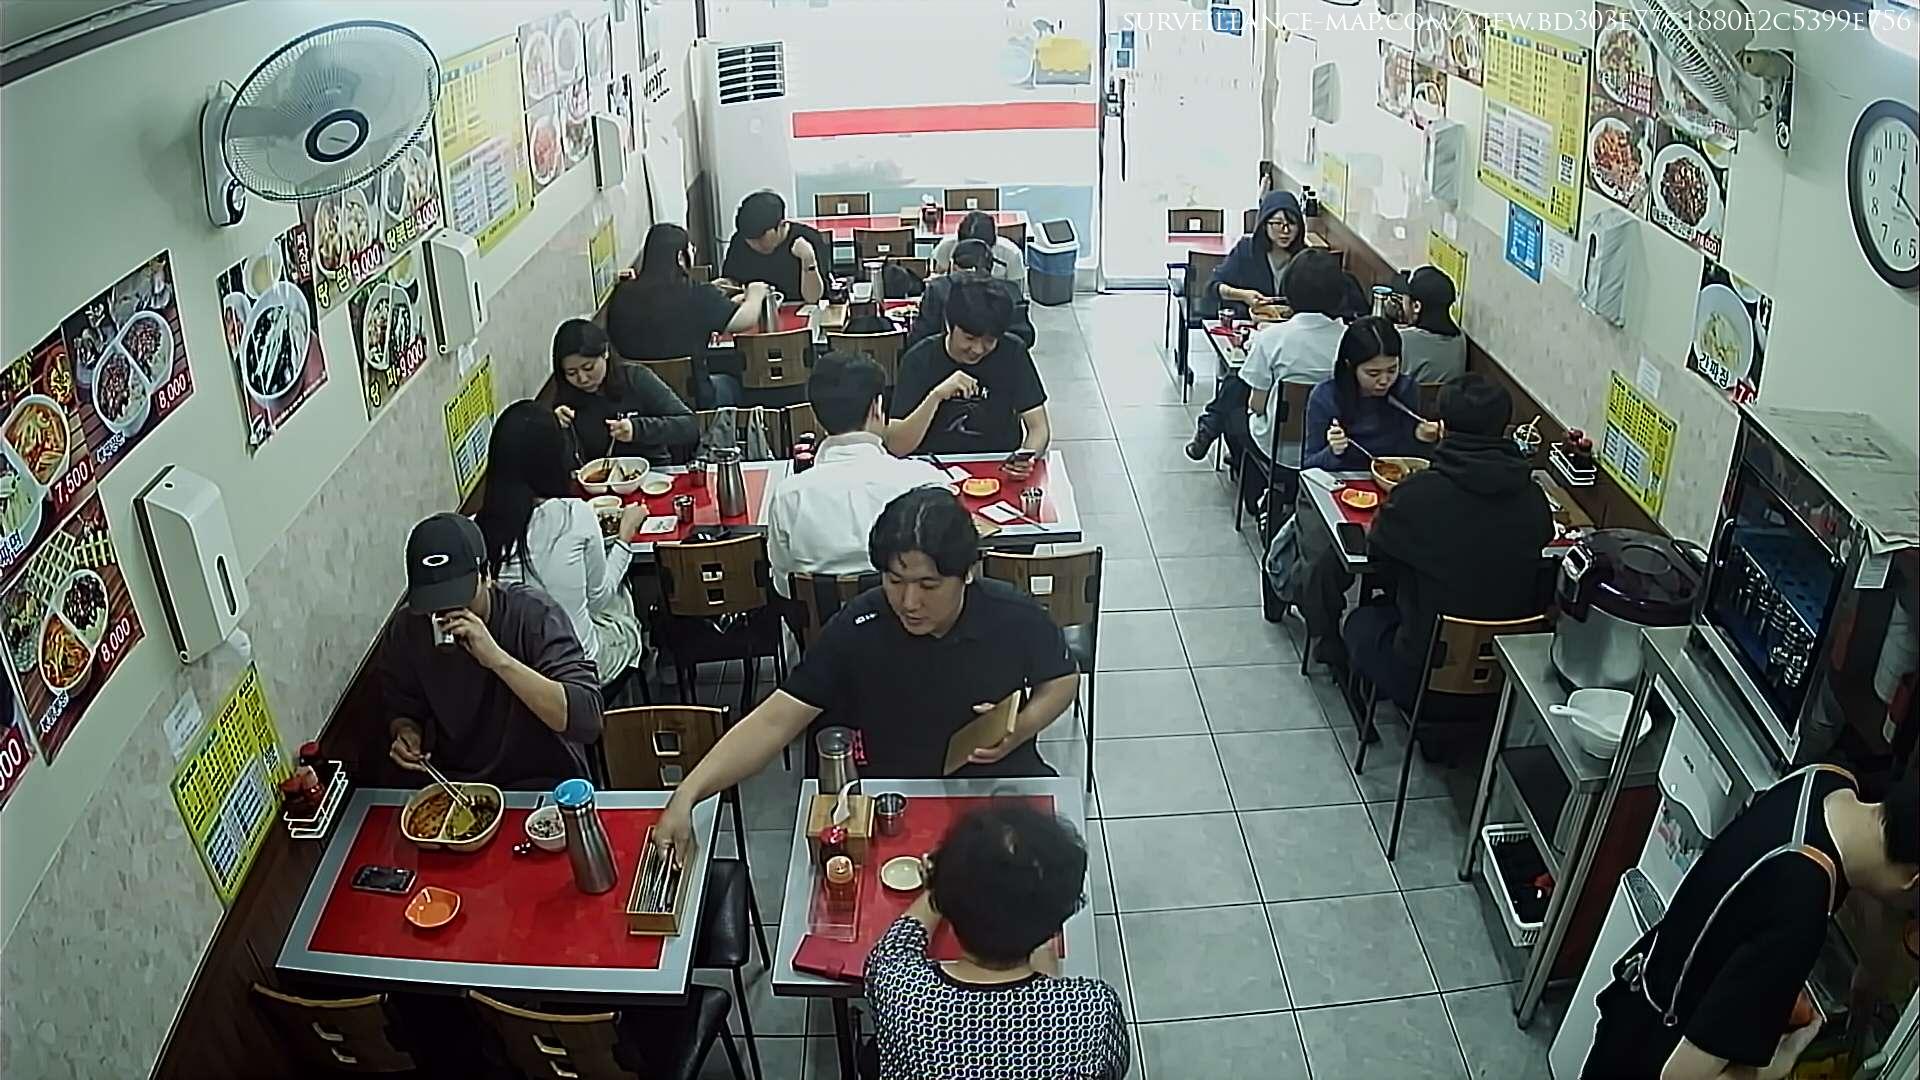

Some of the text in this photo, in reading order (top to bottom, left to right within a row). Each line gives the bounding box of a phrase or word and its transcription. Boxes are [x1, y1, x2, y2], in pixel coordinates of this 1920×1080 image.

[1897, 132, 1907, 151] 12
[1873, 146, 1882, 165] 10
[1868, 169, 1876, 187] 9
[1871, 197, 1879, 216] 8
[1881, 223, 1888, 242] 7
[1893, 238, 1901, 257] 6
[1908, 238, 1917, 258] 5
[352, 243, 380, 280] 9,000
[400, 339, 423, 376] 9,000
[158, 375, 187, 409] 8,000
[54, 462, 88, 504] 7,500
[100, 617, 131, 663] 8,000
